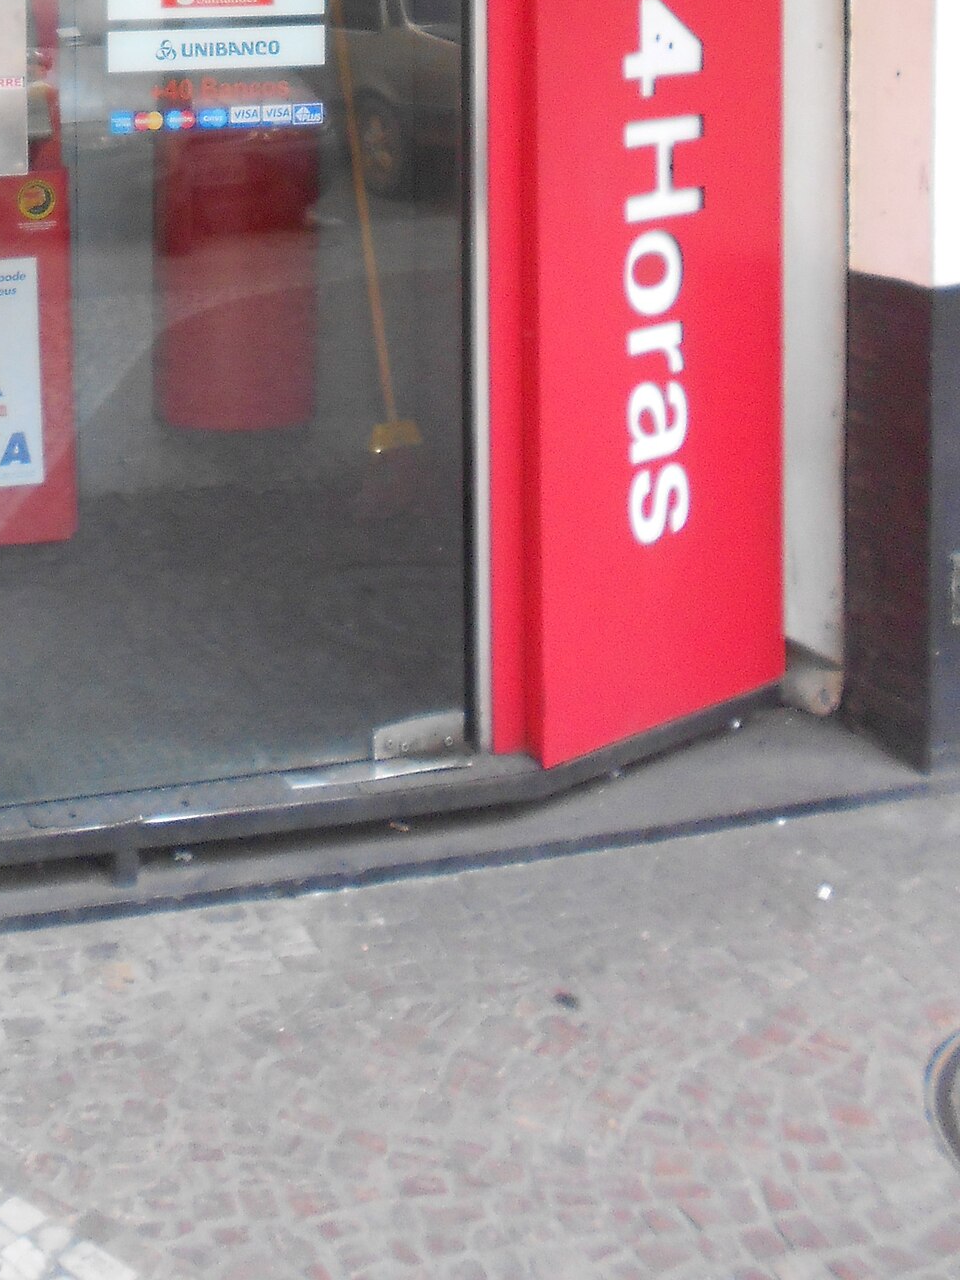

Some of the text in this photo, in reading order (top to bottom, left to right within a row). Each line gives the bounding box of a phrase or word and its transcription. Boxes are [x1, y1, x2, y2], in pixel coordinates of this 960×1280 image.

[181, 40, 280, 58] UNIBANCO
[234, 108, 259, 119] VISA
[266, 107, 290, 118] VISA
